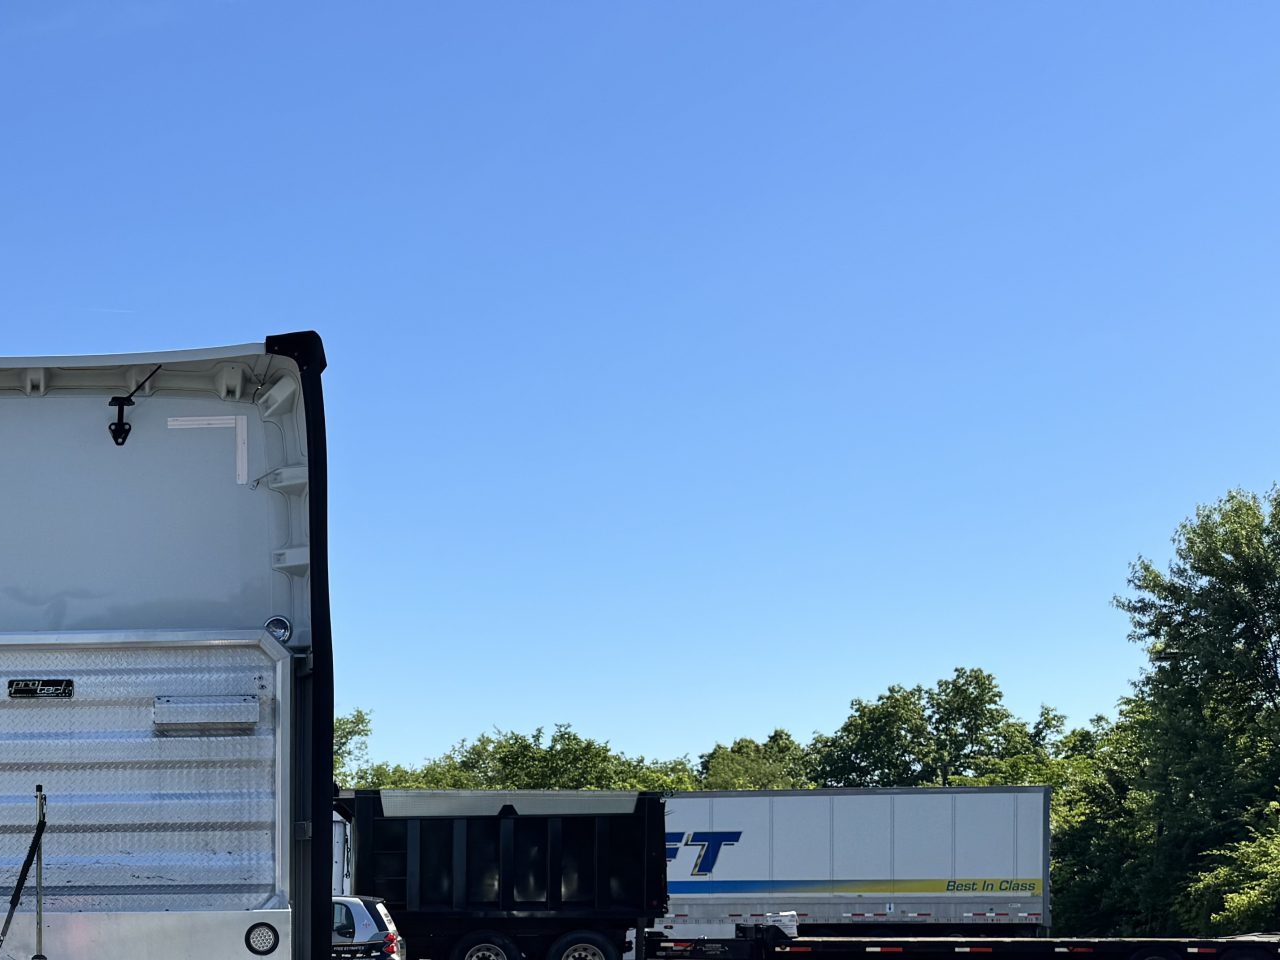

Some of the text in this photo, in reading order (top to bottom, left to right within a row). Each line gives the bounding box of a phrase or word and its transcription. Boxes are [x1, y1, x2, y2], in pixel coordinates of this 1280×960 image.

[946, 880, 1036, 892] Best In Class
